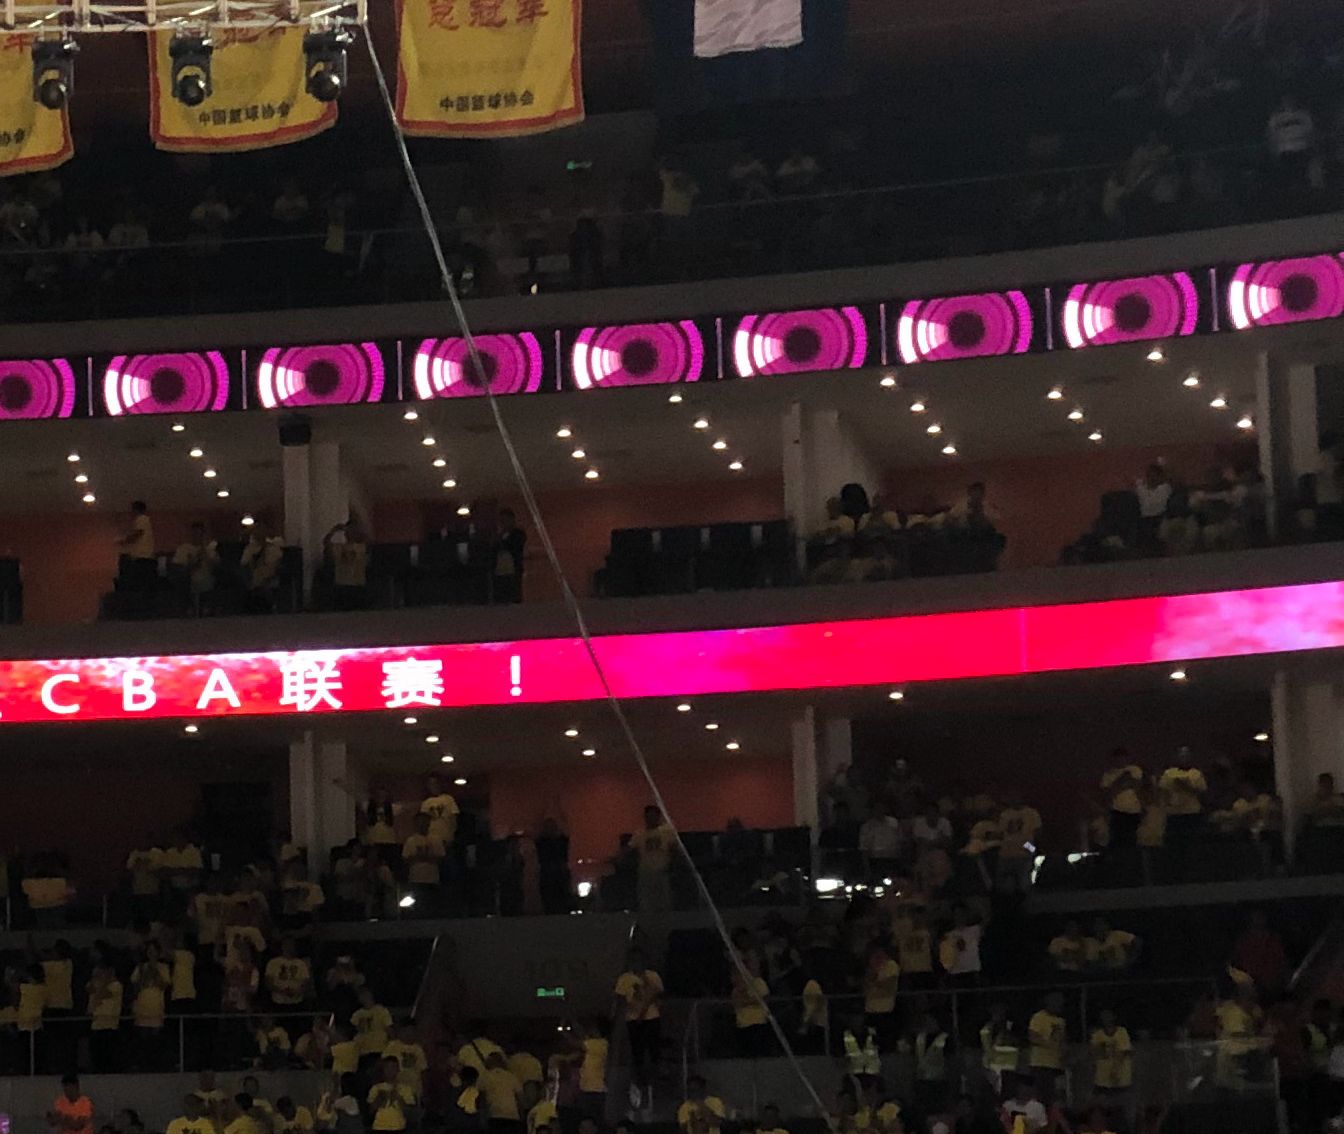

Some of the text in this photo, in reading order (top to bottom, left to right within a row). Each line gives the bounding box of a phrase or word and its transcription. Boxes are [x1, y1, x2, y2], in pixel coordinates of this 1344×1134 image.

[439, 90, 534, 113] 中国篮球协会
[199, 102, 290, 127] 中国篮球协会
